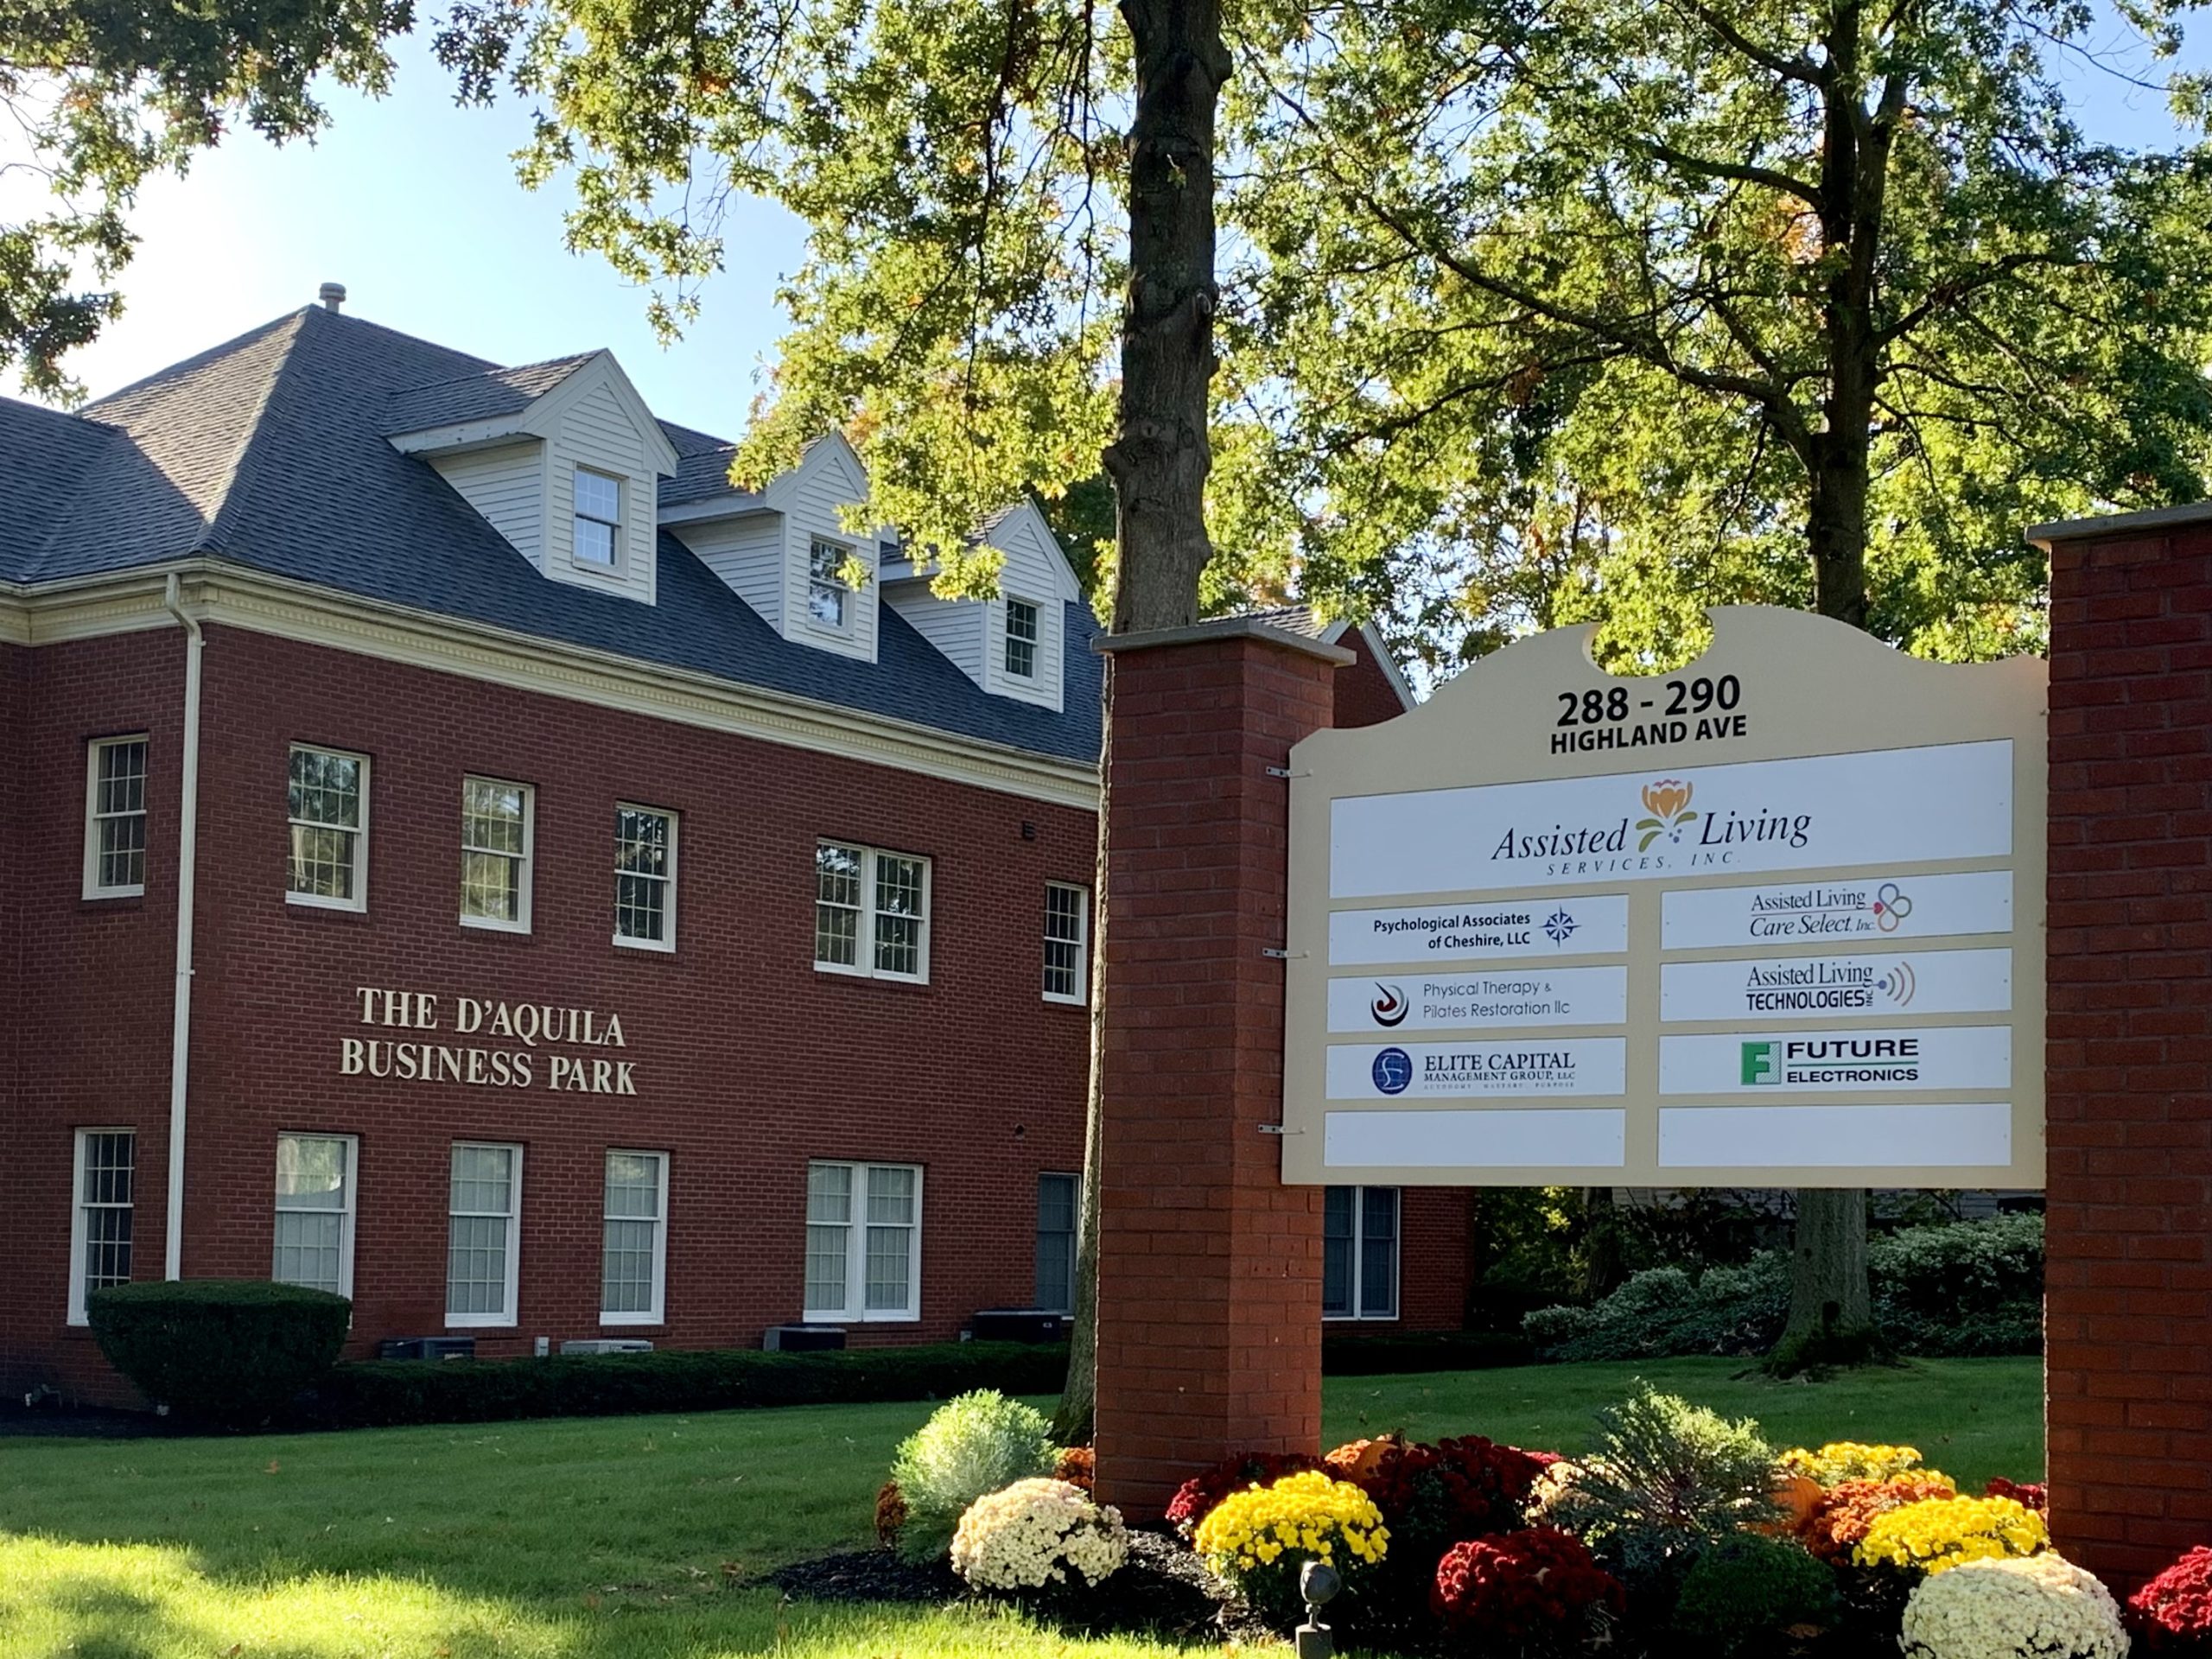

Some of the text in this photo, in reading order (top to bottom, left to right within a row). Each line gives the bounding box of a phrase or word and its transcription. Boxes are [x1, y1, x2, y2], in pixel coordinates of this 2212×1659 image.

[1557, 687, 1629, 727] 288
[1665, 675, 1740, 715] 290
[1551, 715, 1746, 754] HIGHLAND AVE
[1491, 808, 1812, 861] Assisted Living
[1751, 888, 1866, 912] Assisted Living
[1374, 912, 1530, 935] Psychological Associates
[1750, 917, 1796, 937] Care
[1428, 931, 1530, 949] of Cheshire, LLC
[1747, 961, 1873, 988] Assisted Living
[1424, 981, 1552, 999] Physical Therapy &
[1746, 990, 1865, 1011] TECHNOLOGIES
[357, 987, 626, 1047] THE D'AQUILA
[1423, 1001, 1571, 1018] Pilates Restoration llc
[1788, 1039, 1918, 1058] FUTURE
[339, 1038, 638, 1096] BUSINESS PARK
[1425, 1052, 1576, 1071] ELITE CAPITAL
[1424, 1071, 1509, 1082] MANAGEMENT
[1510, 1071, 1554, 1081] GROUP,
[1787, 1069, 1918, 1083] ELECTRONICS
